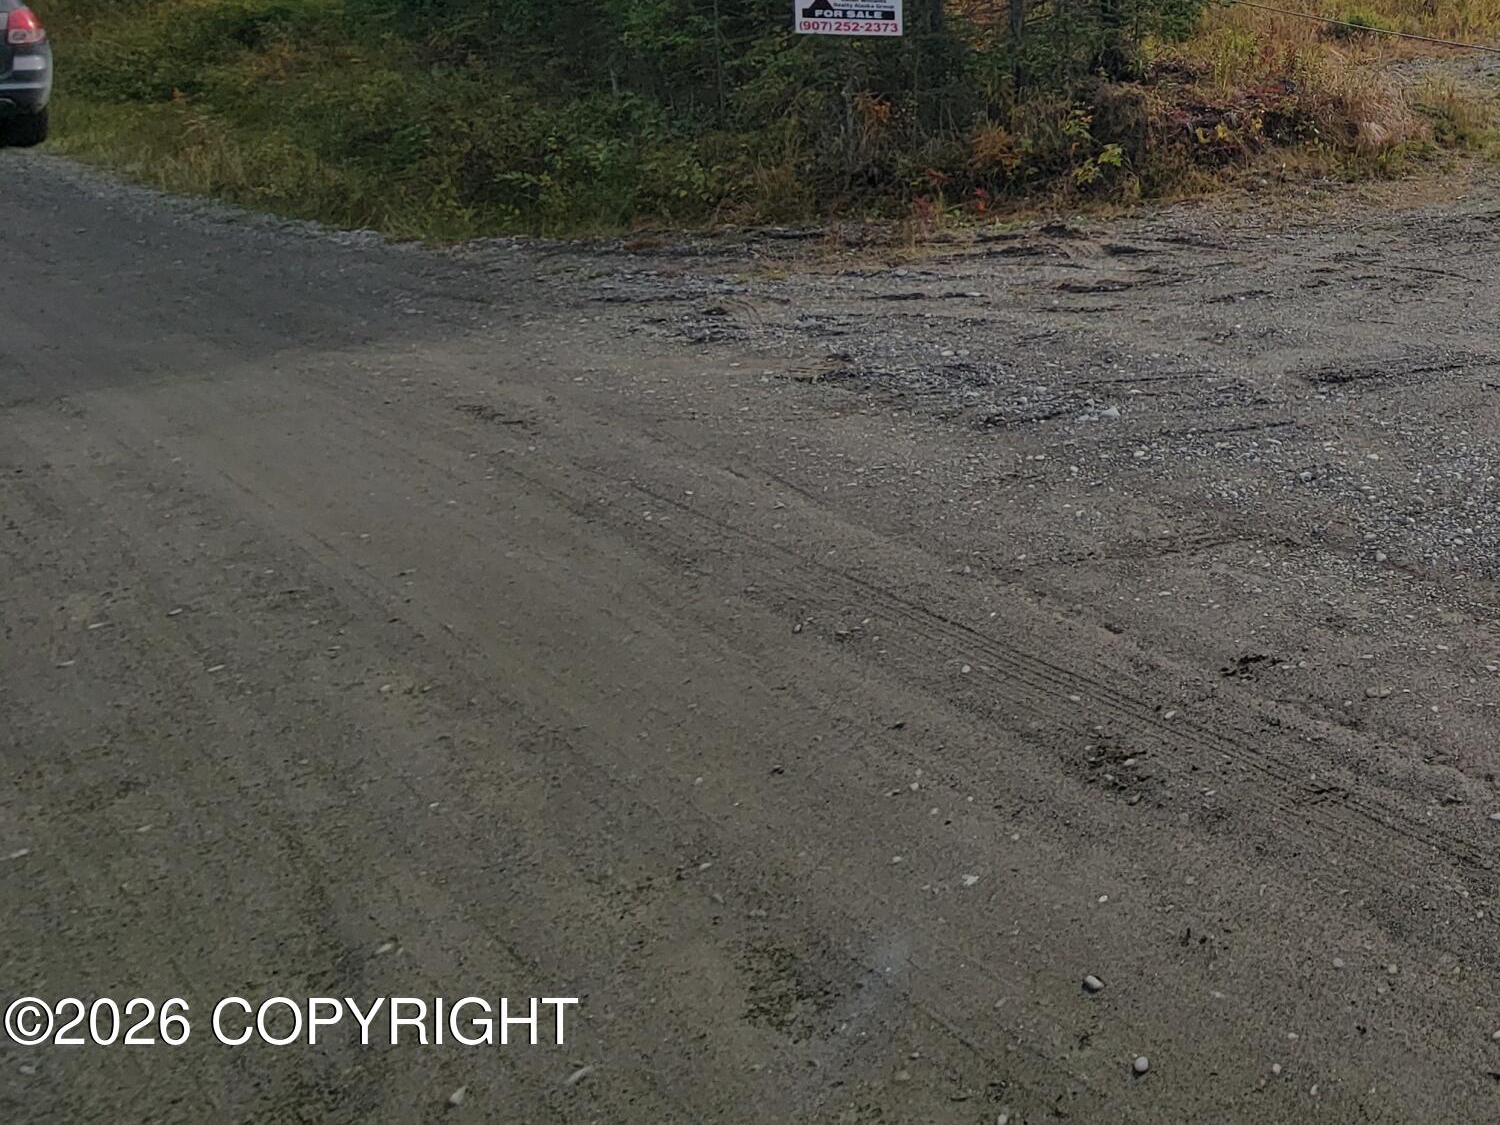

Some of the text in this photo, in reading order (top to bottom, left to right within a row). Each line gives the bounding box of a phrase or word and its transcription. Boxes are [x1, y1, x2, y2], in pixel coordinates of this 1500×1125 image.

[815, 9, 883, 19] FOR SALE
[799, 21, 898, 33] (907) 252-2373
